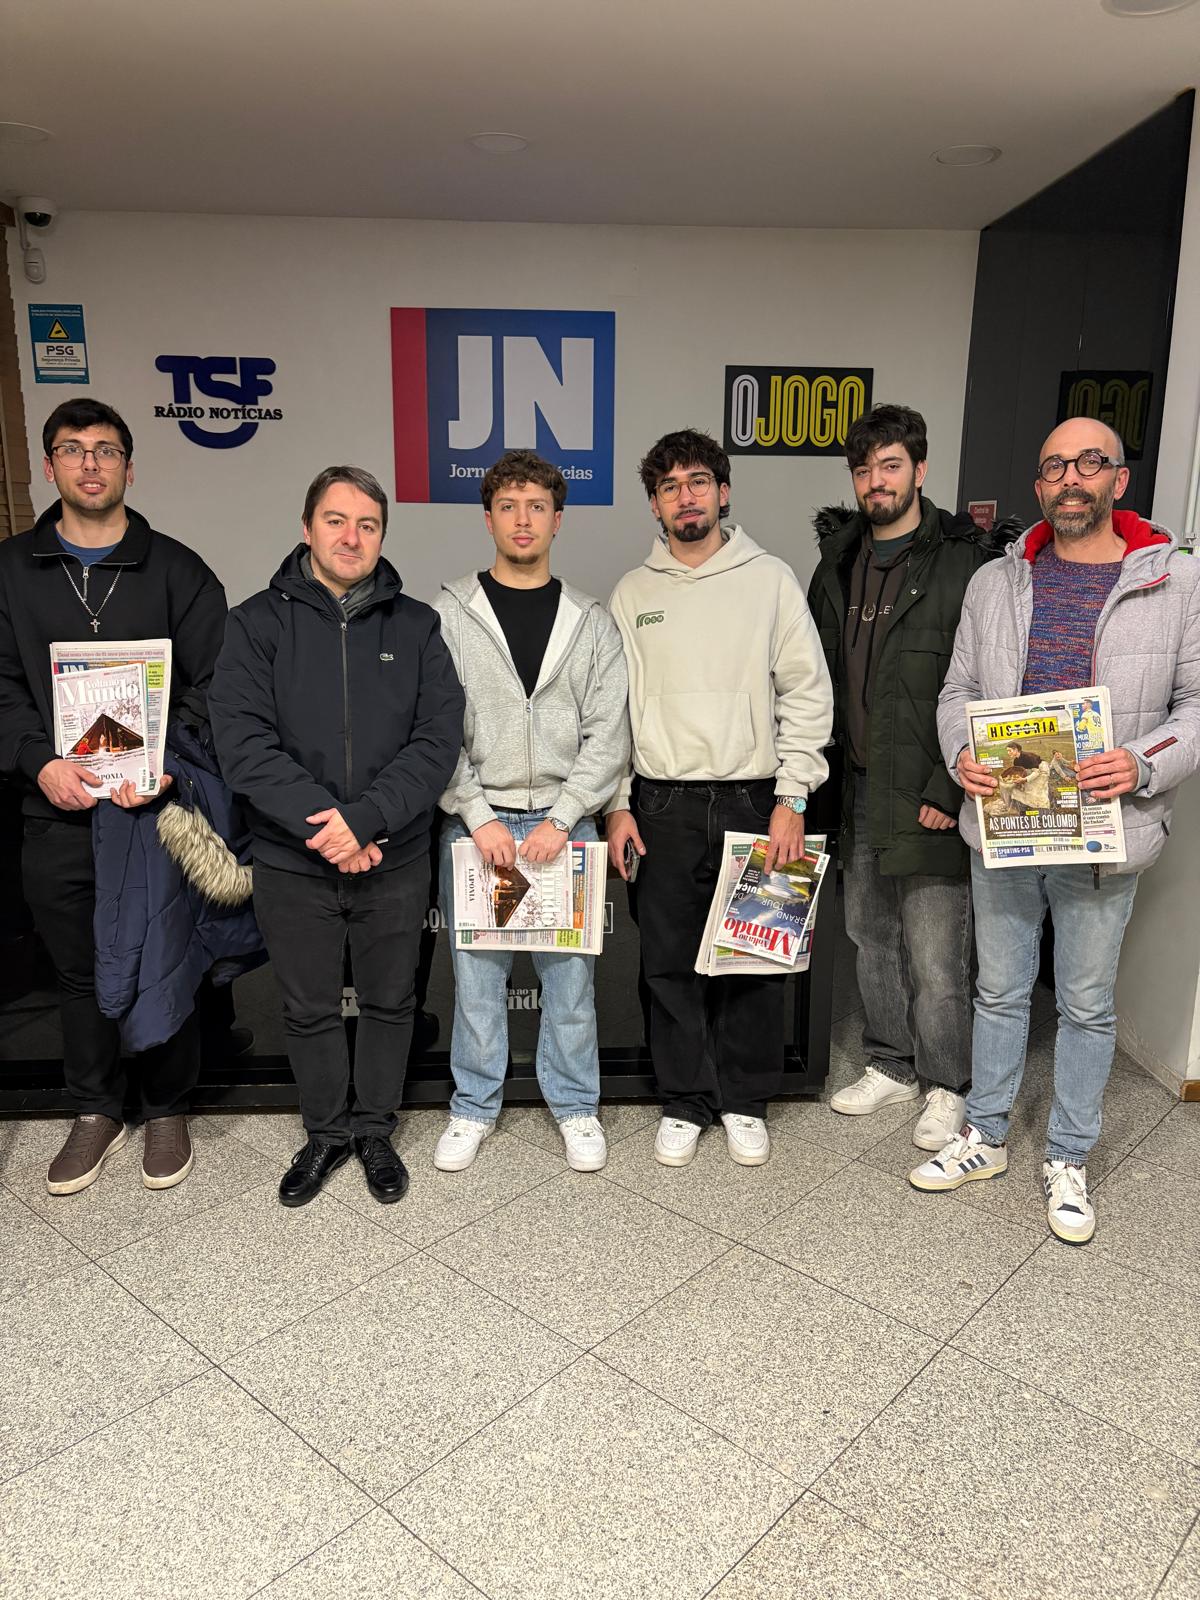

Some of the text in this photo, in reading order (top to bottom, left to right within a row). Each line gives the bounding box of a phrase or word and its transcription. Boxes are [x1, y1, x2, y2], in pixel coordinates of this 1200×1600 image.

[46, 345, 74, 356] PSG
[448, 335, 595, 451] JN
[155, 355, 276, 449] TSF
[730, 374, 865, 447] O JOGO
[154, 403, 283, 420] RÁDIO NOTÍCIAS
[449, 463, 593, 480] Jorn cias
[58, 679, 139, 707] Mundo
[989, 817, 1000, 831] AS
[1000, 815, 1030, 830] PONTES
[1030, 815, 1040, 829] DE
[1042, 813, 1078, 828] COLOMBO
[761, 898, 785, 911] TOUR
[776, 911, 807, 926] GRAND
[724, 917, 797, 957] Mundo
[749, 934, 769, 949] Volta
